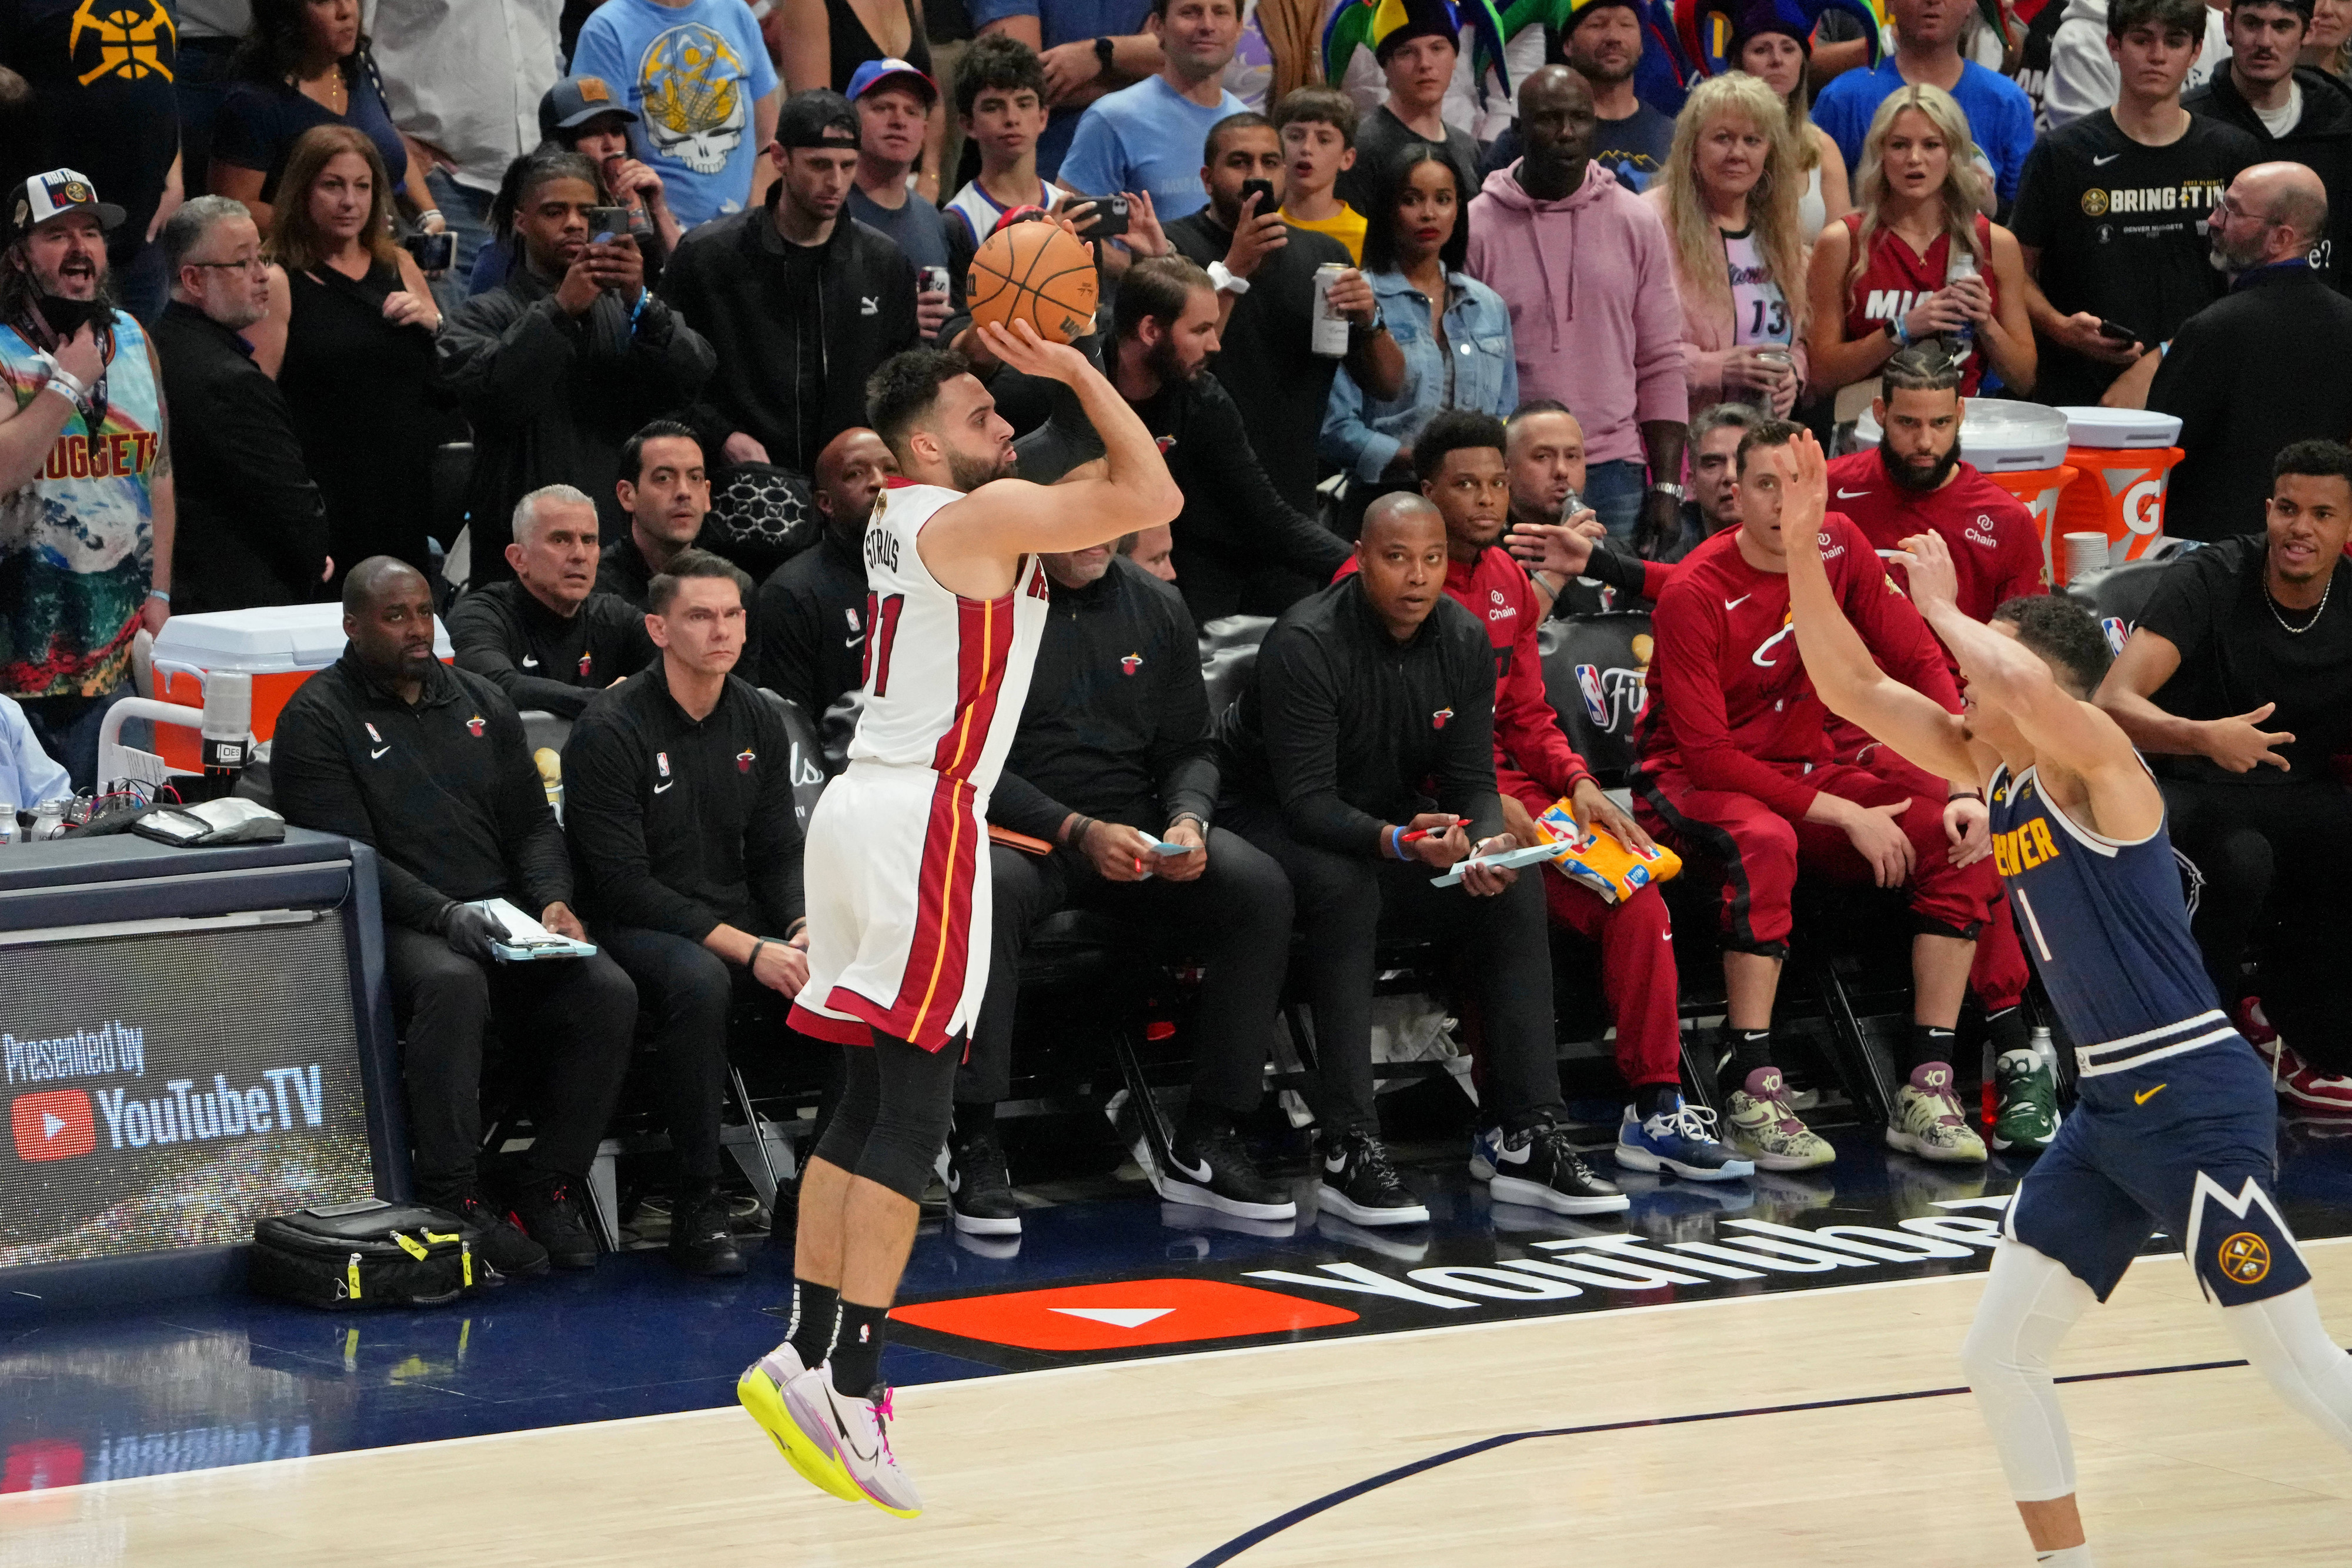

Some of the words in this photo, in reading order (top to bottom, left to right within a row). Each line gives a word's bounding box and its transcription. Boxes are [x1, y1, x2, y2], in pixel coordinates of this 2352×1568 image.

[44, 170, 66, 186] NBA
[2110, 187, 2176, 212] BRING
[2178, 186, 2202, 208] IT
[1750, 299, 1789, 337] 13
[34, 432, 158, 480] UGGETS
[1965, 527, 1997, 547] Chain
[866, 529, 899, 574] STRUS
[1819, 544, 1845, 560] hain
[1489, 605, 1516, 621] Chain
[2017, 888, 2052, 961] 1
